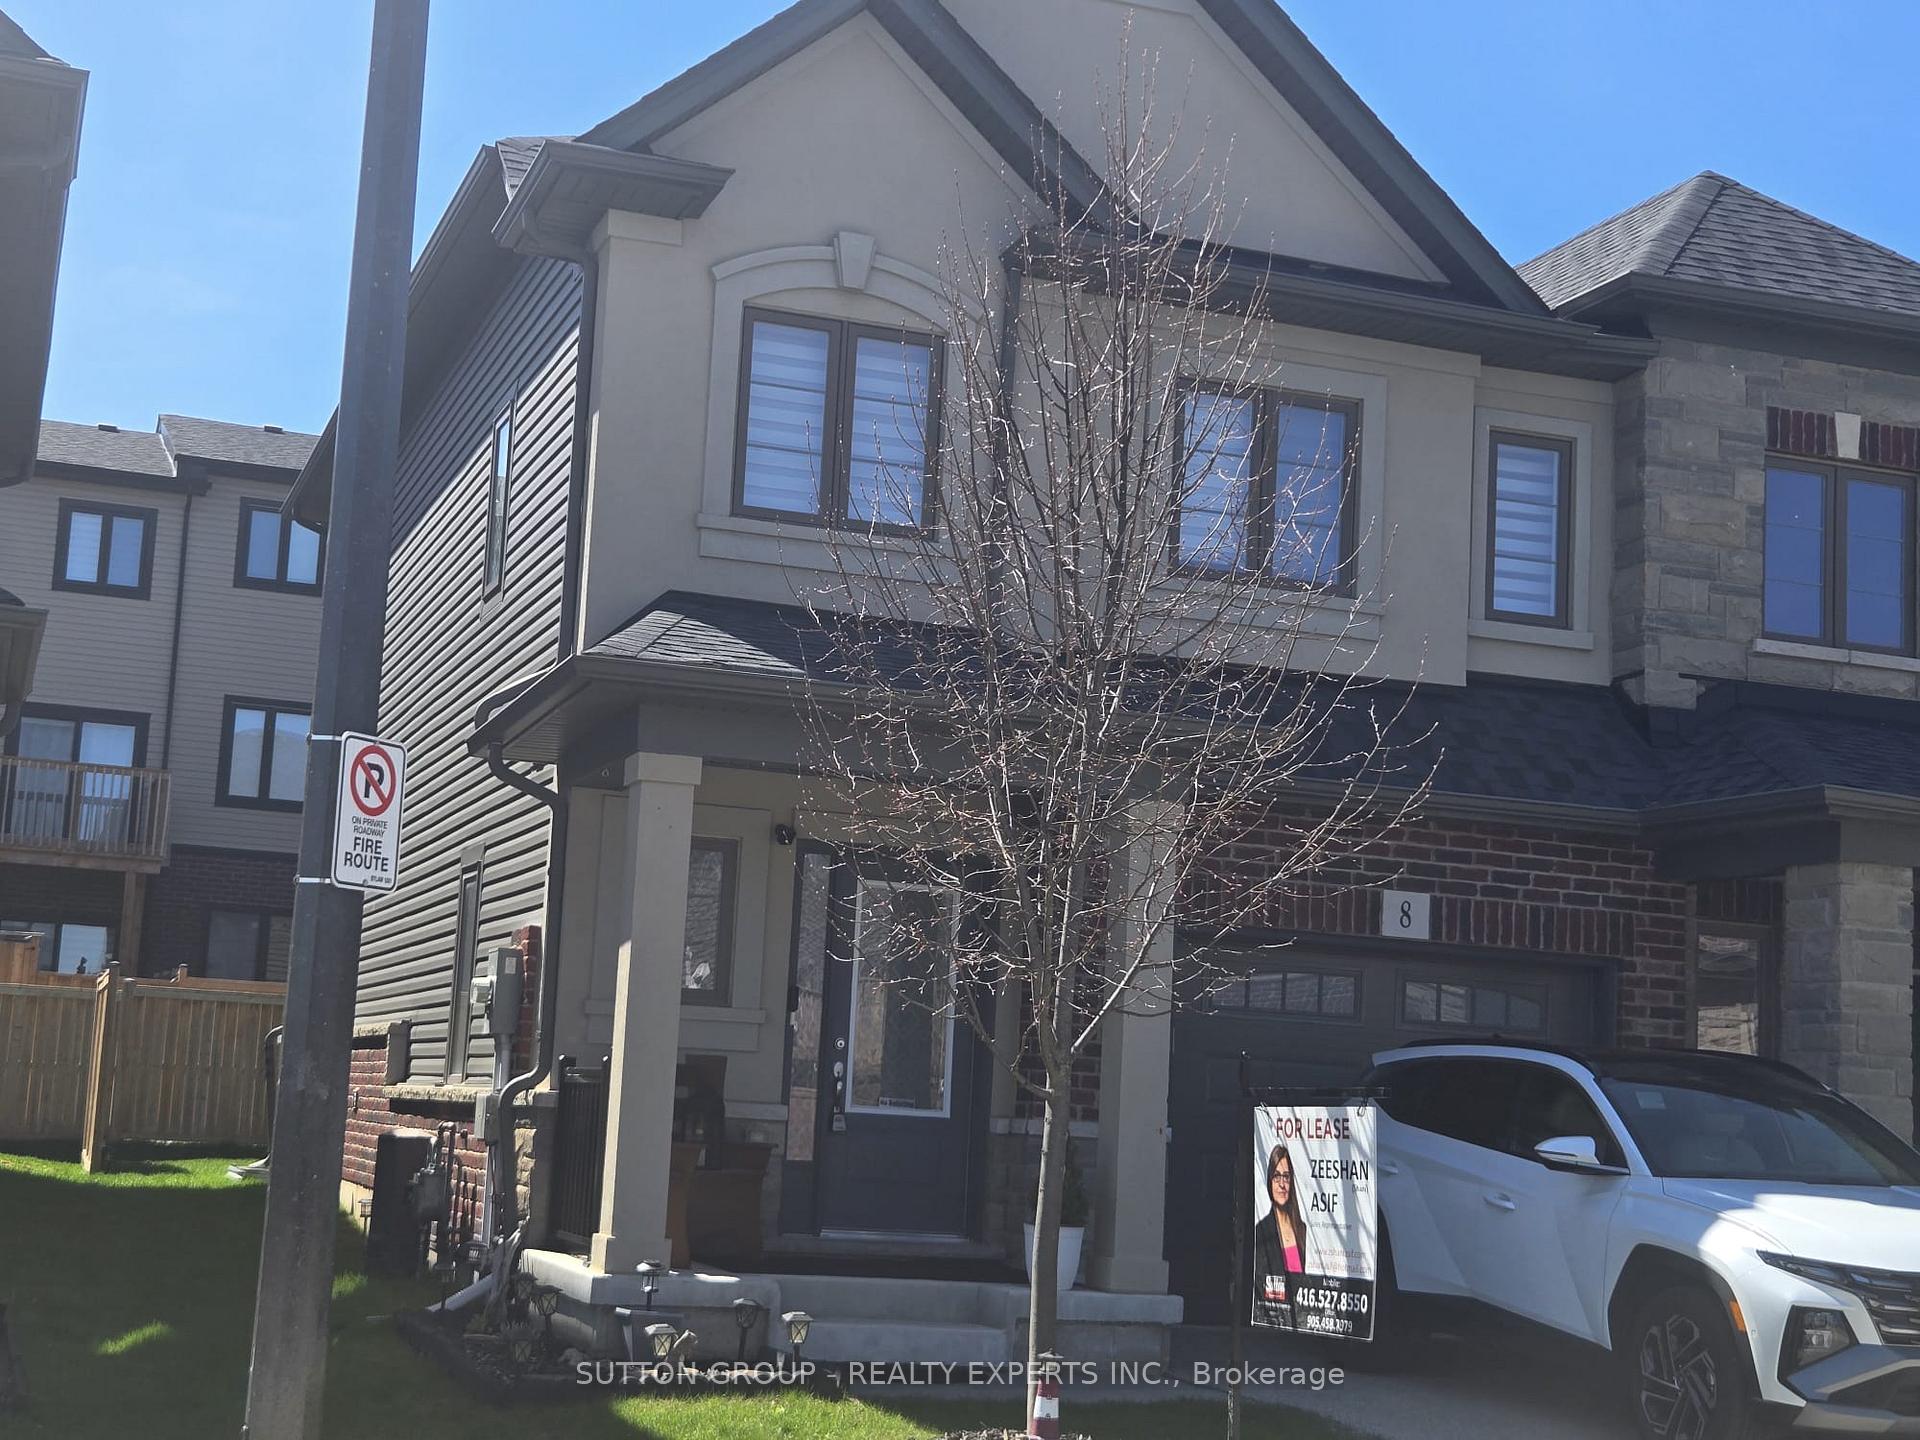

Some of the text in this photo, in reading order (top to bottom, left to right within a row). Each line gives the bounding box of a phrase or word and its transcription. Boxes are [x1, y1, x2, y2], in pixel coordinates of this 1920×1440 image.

[352, 816, 389, 830] ON PRIVATE
[353, 825, 386, 837] ROADWAY
[353, 836, 383, 855] FIRE
[344, 851, 389, 872] ROUTE
[1400, 900, 1411, 928] 8
[1276, 1117, 1350, 1140] FOR LEASE
[1310, 1159, 1369, 1181] ZEESHAN
[1310, 1192, 1338, 1213] ASIF
[1296, 1287, 1368, 1313] 416.527.8550
